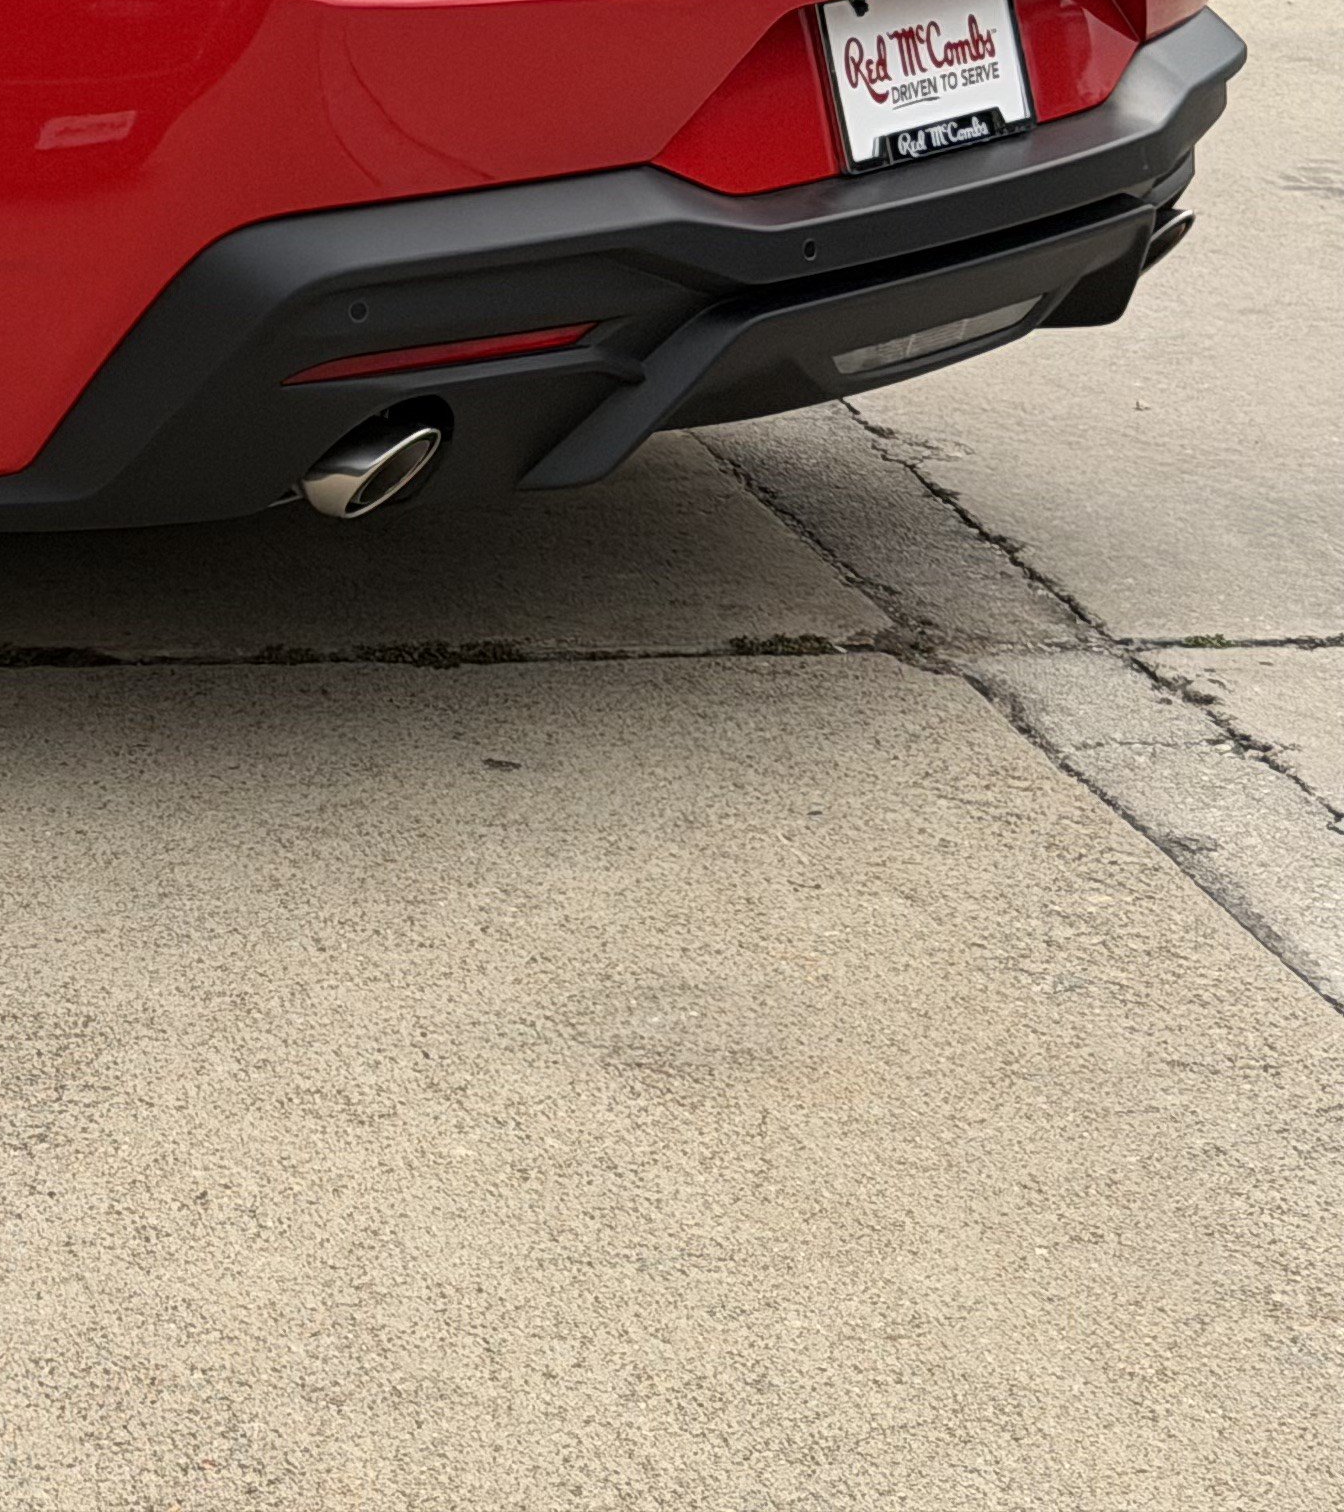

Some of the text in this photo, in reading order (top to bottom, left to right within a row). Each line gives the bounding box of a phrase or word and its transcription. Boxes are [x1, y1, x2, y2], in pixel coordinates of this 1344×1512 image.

[844, 14, 996, 104] Red McCombs
[891, 61, 1000, 105] DRIVEN TO SERVE
[897, 130, 927, 158] Red
